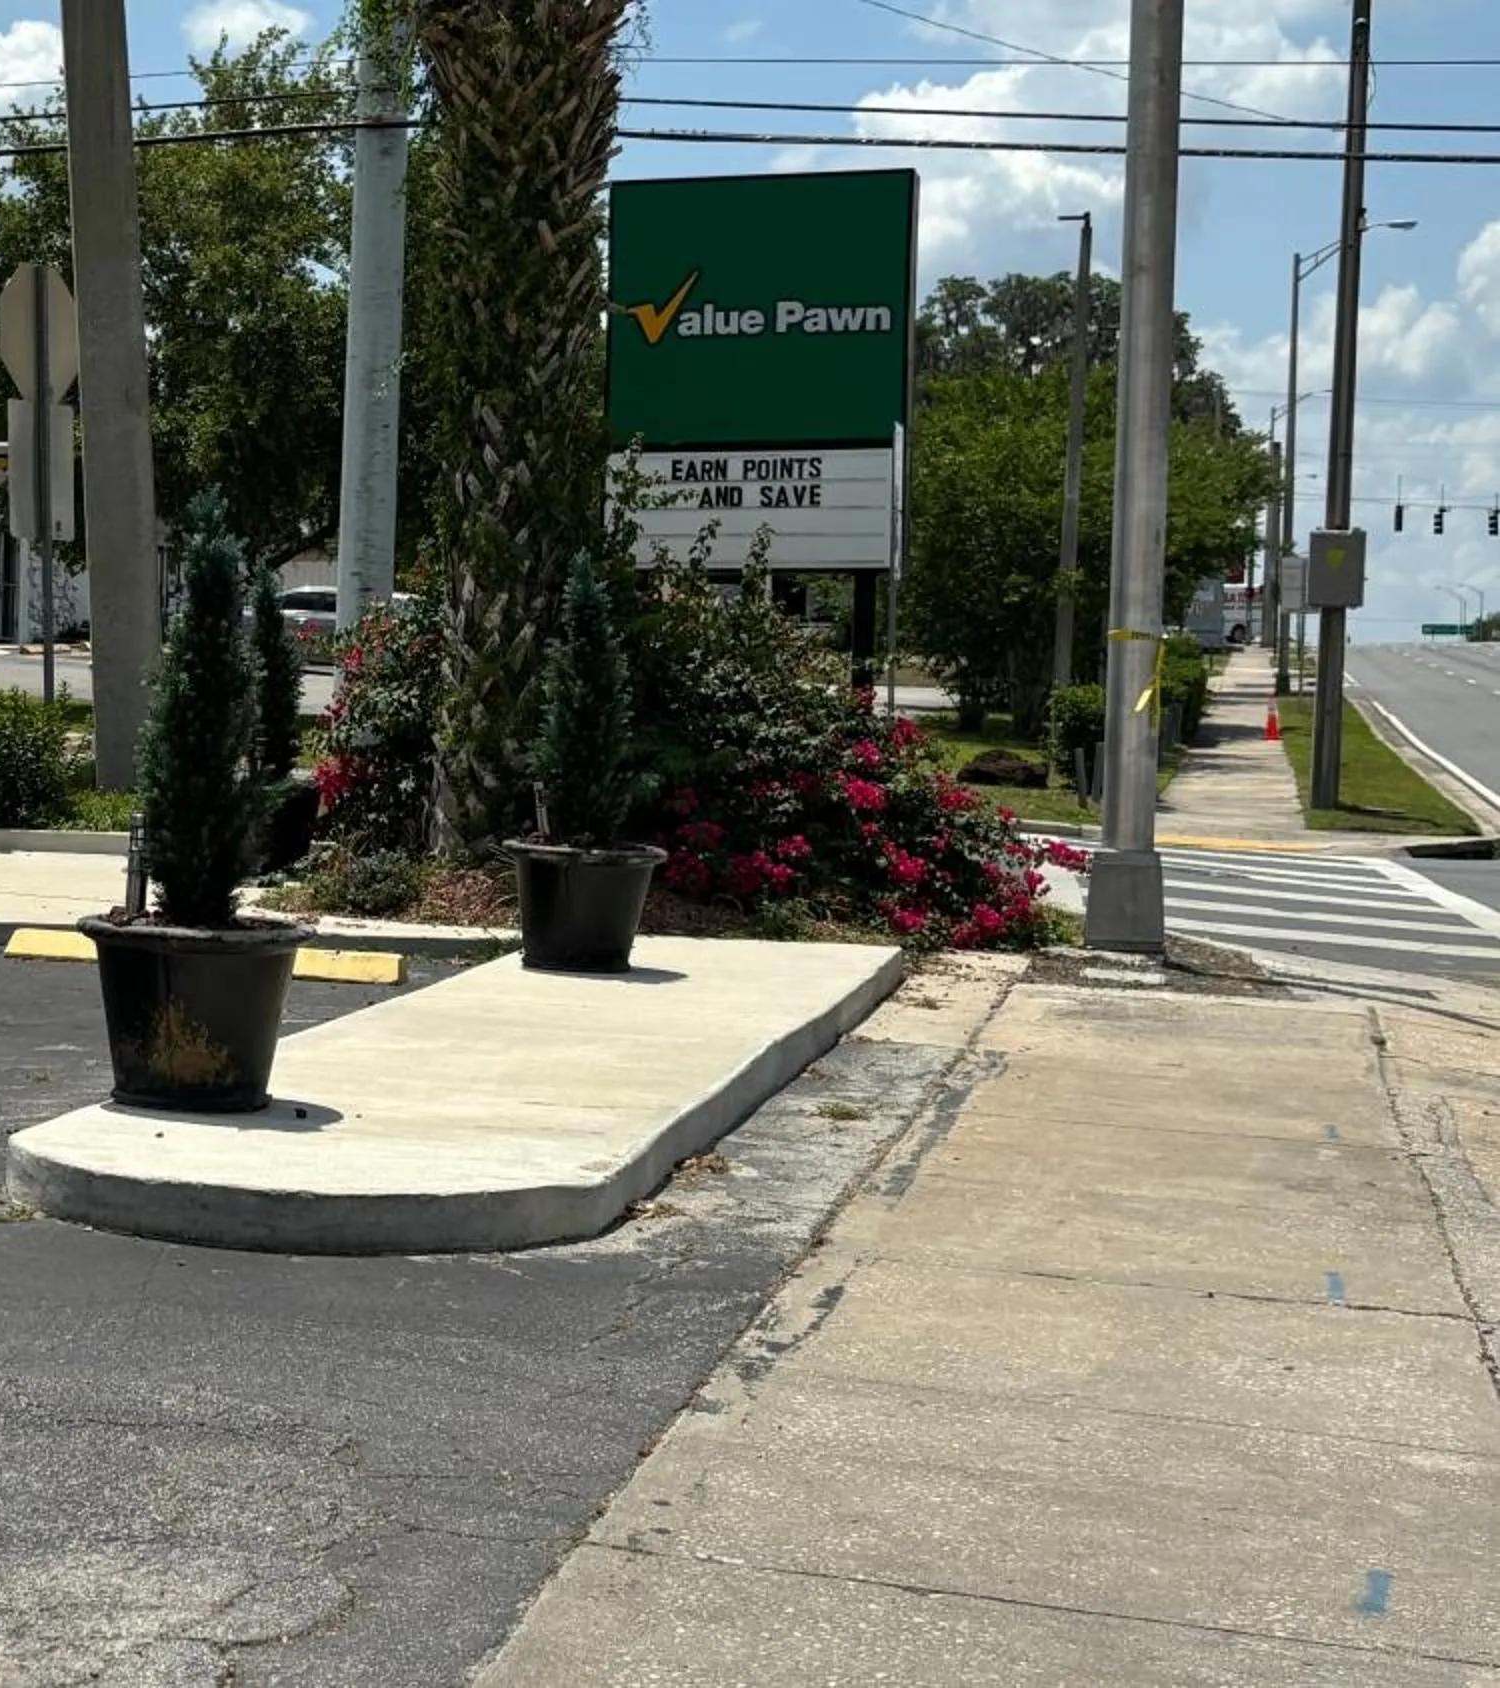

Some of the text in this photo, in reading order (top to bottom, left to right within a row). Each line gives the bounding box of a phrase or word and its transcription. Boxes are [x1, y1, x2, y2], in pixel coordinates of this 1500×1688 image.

[627, 271, 891, 343] Value Pawn
[671, 457, 822, 480] EARN POINTS
[698, 485, 821, 508] AND SAVE
